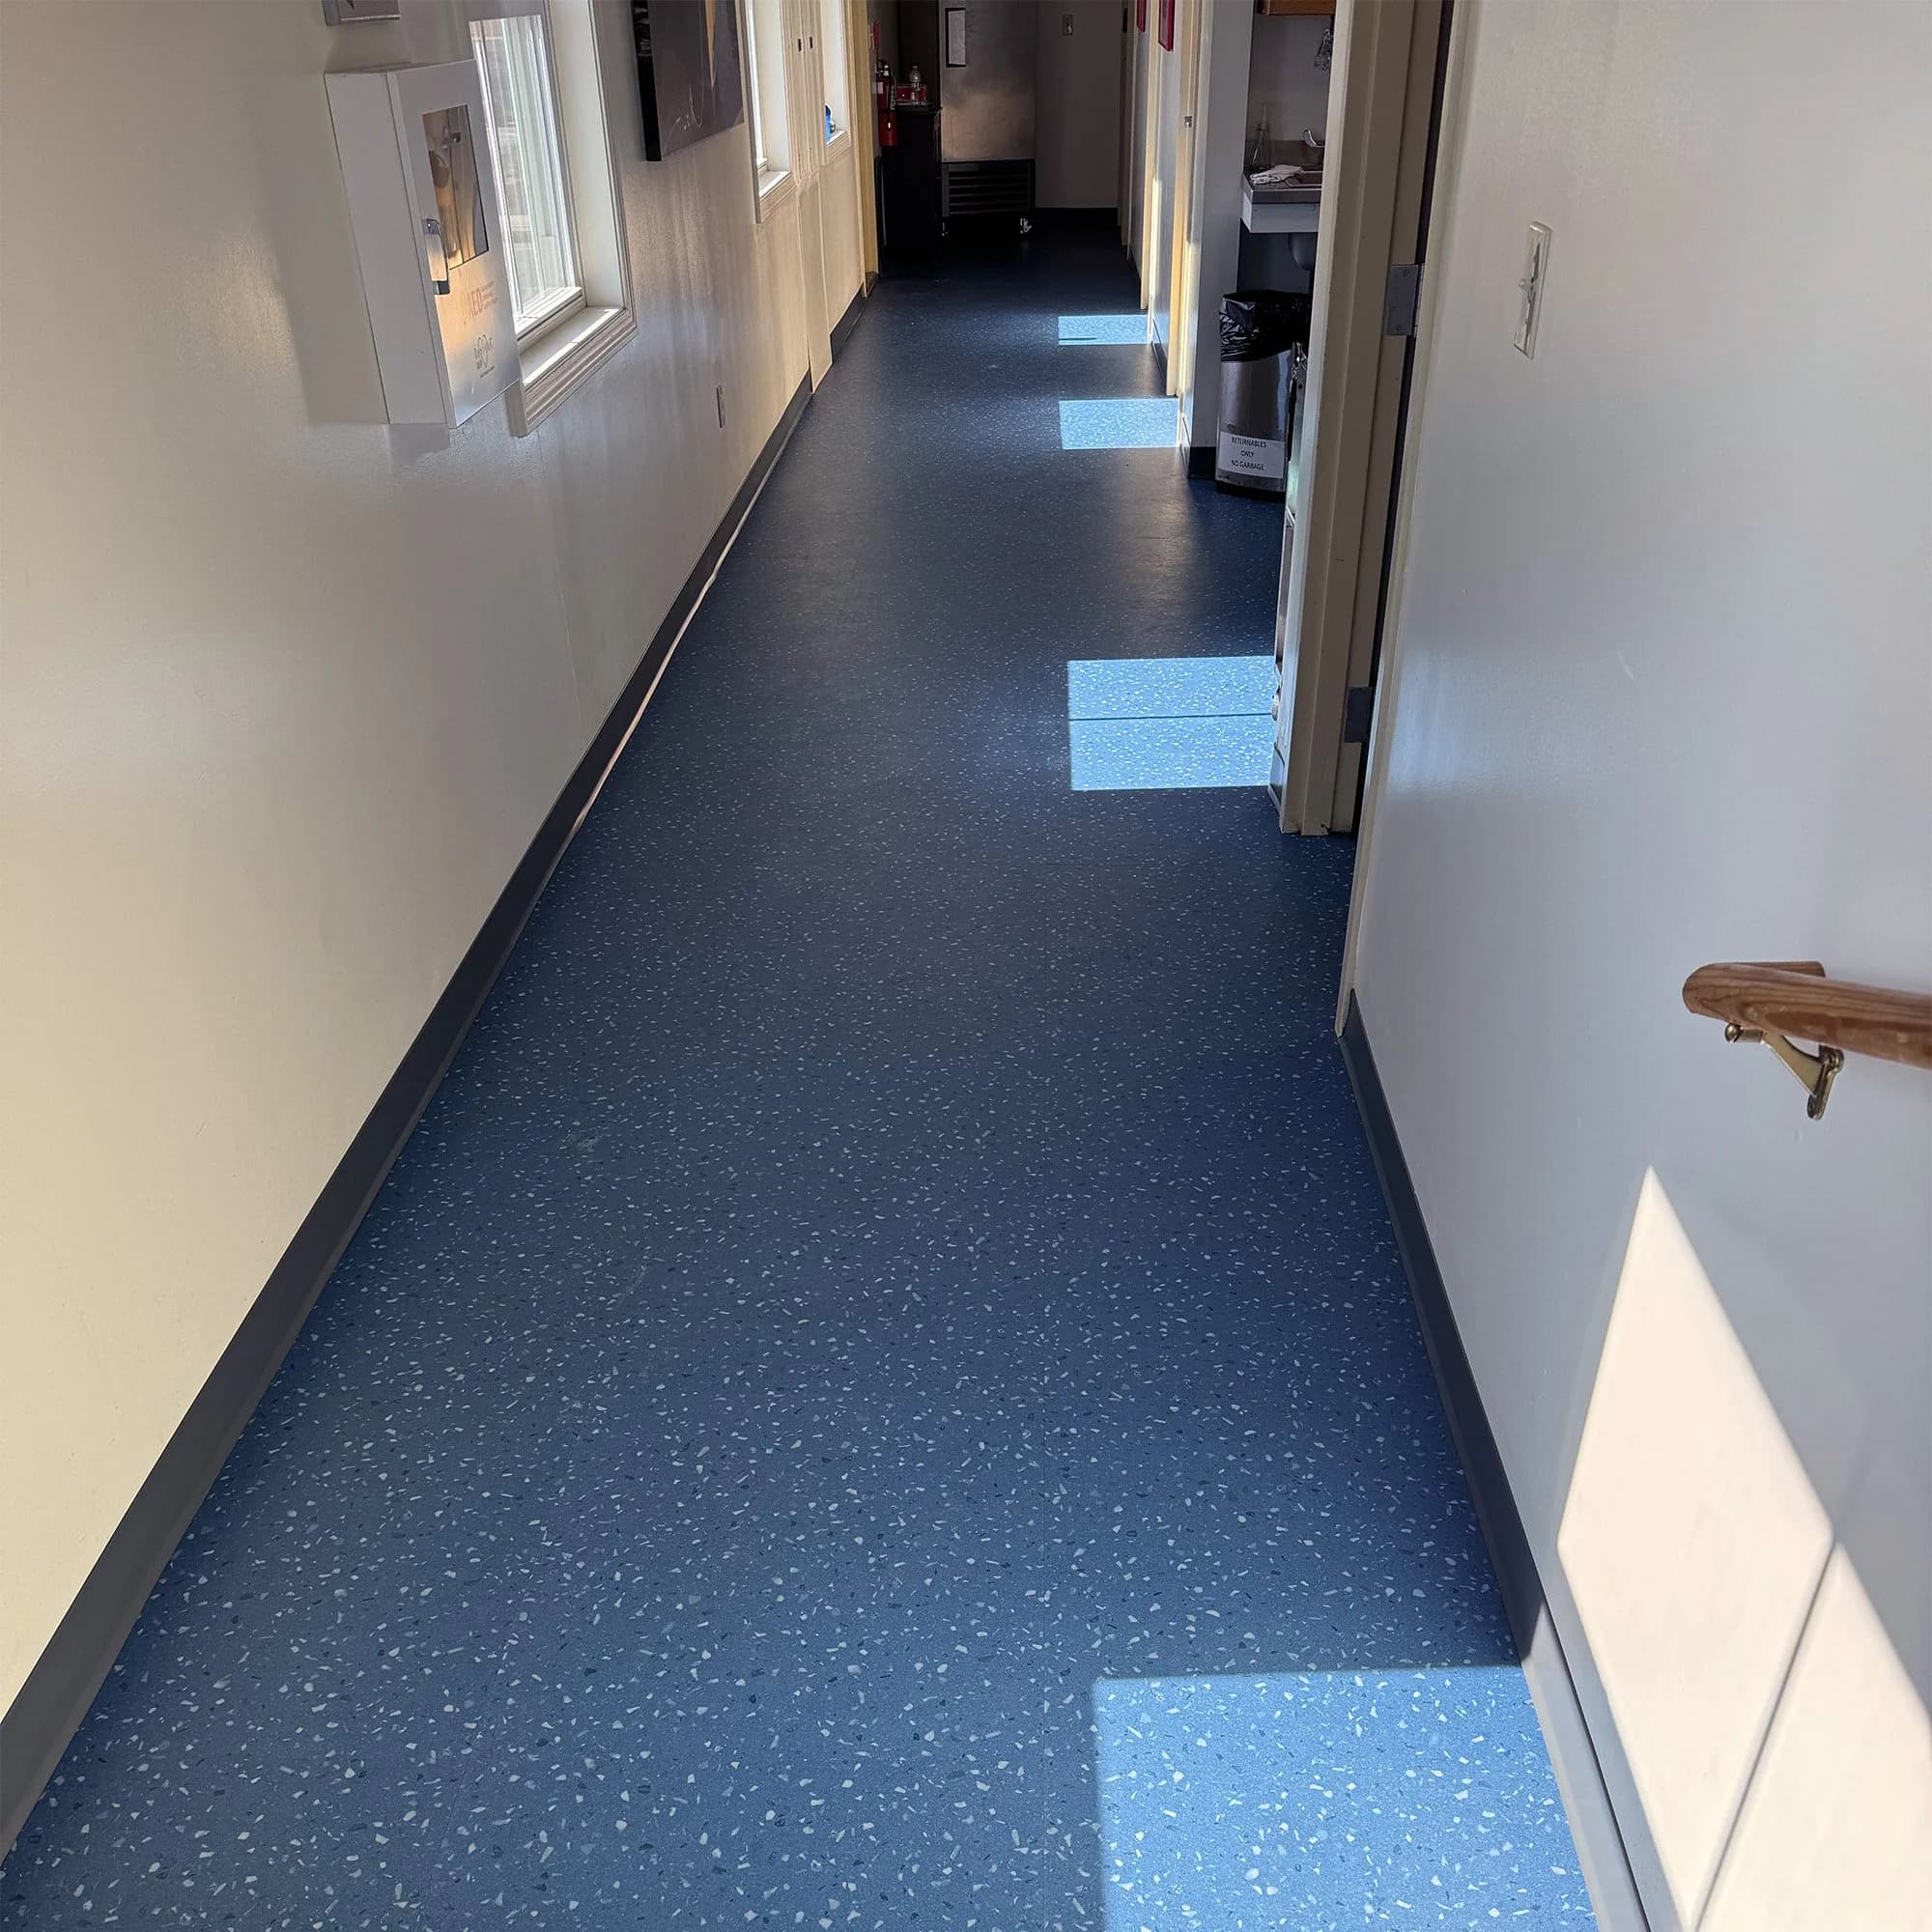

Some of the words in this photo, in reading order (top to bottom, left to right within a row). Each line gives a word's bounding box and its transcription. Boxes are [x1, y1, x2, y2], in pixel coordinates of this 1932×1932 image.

[1231, 436, 1266, 448] RETURNABLES
[1240, 449, 1254, 458] ONLY
[1239, 461, 1264, 471] GARBAGE
